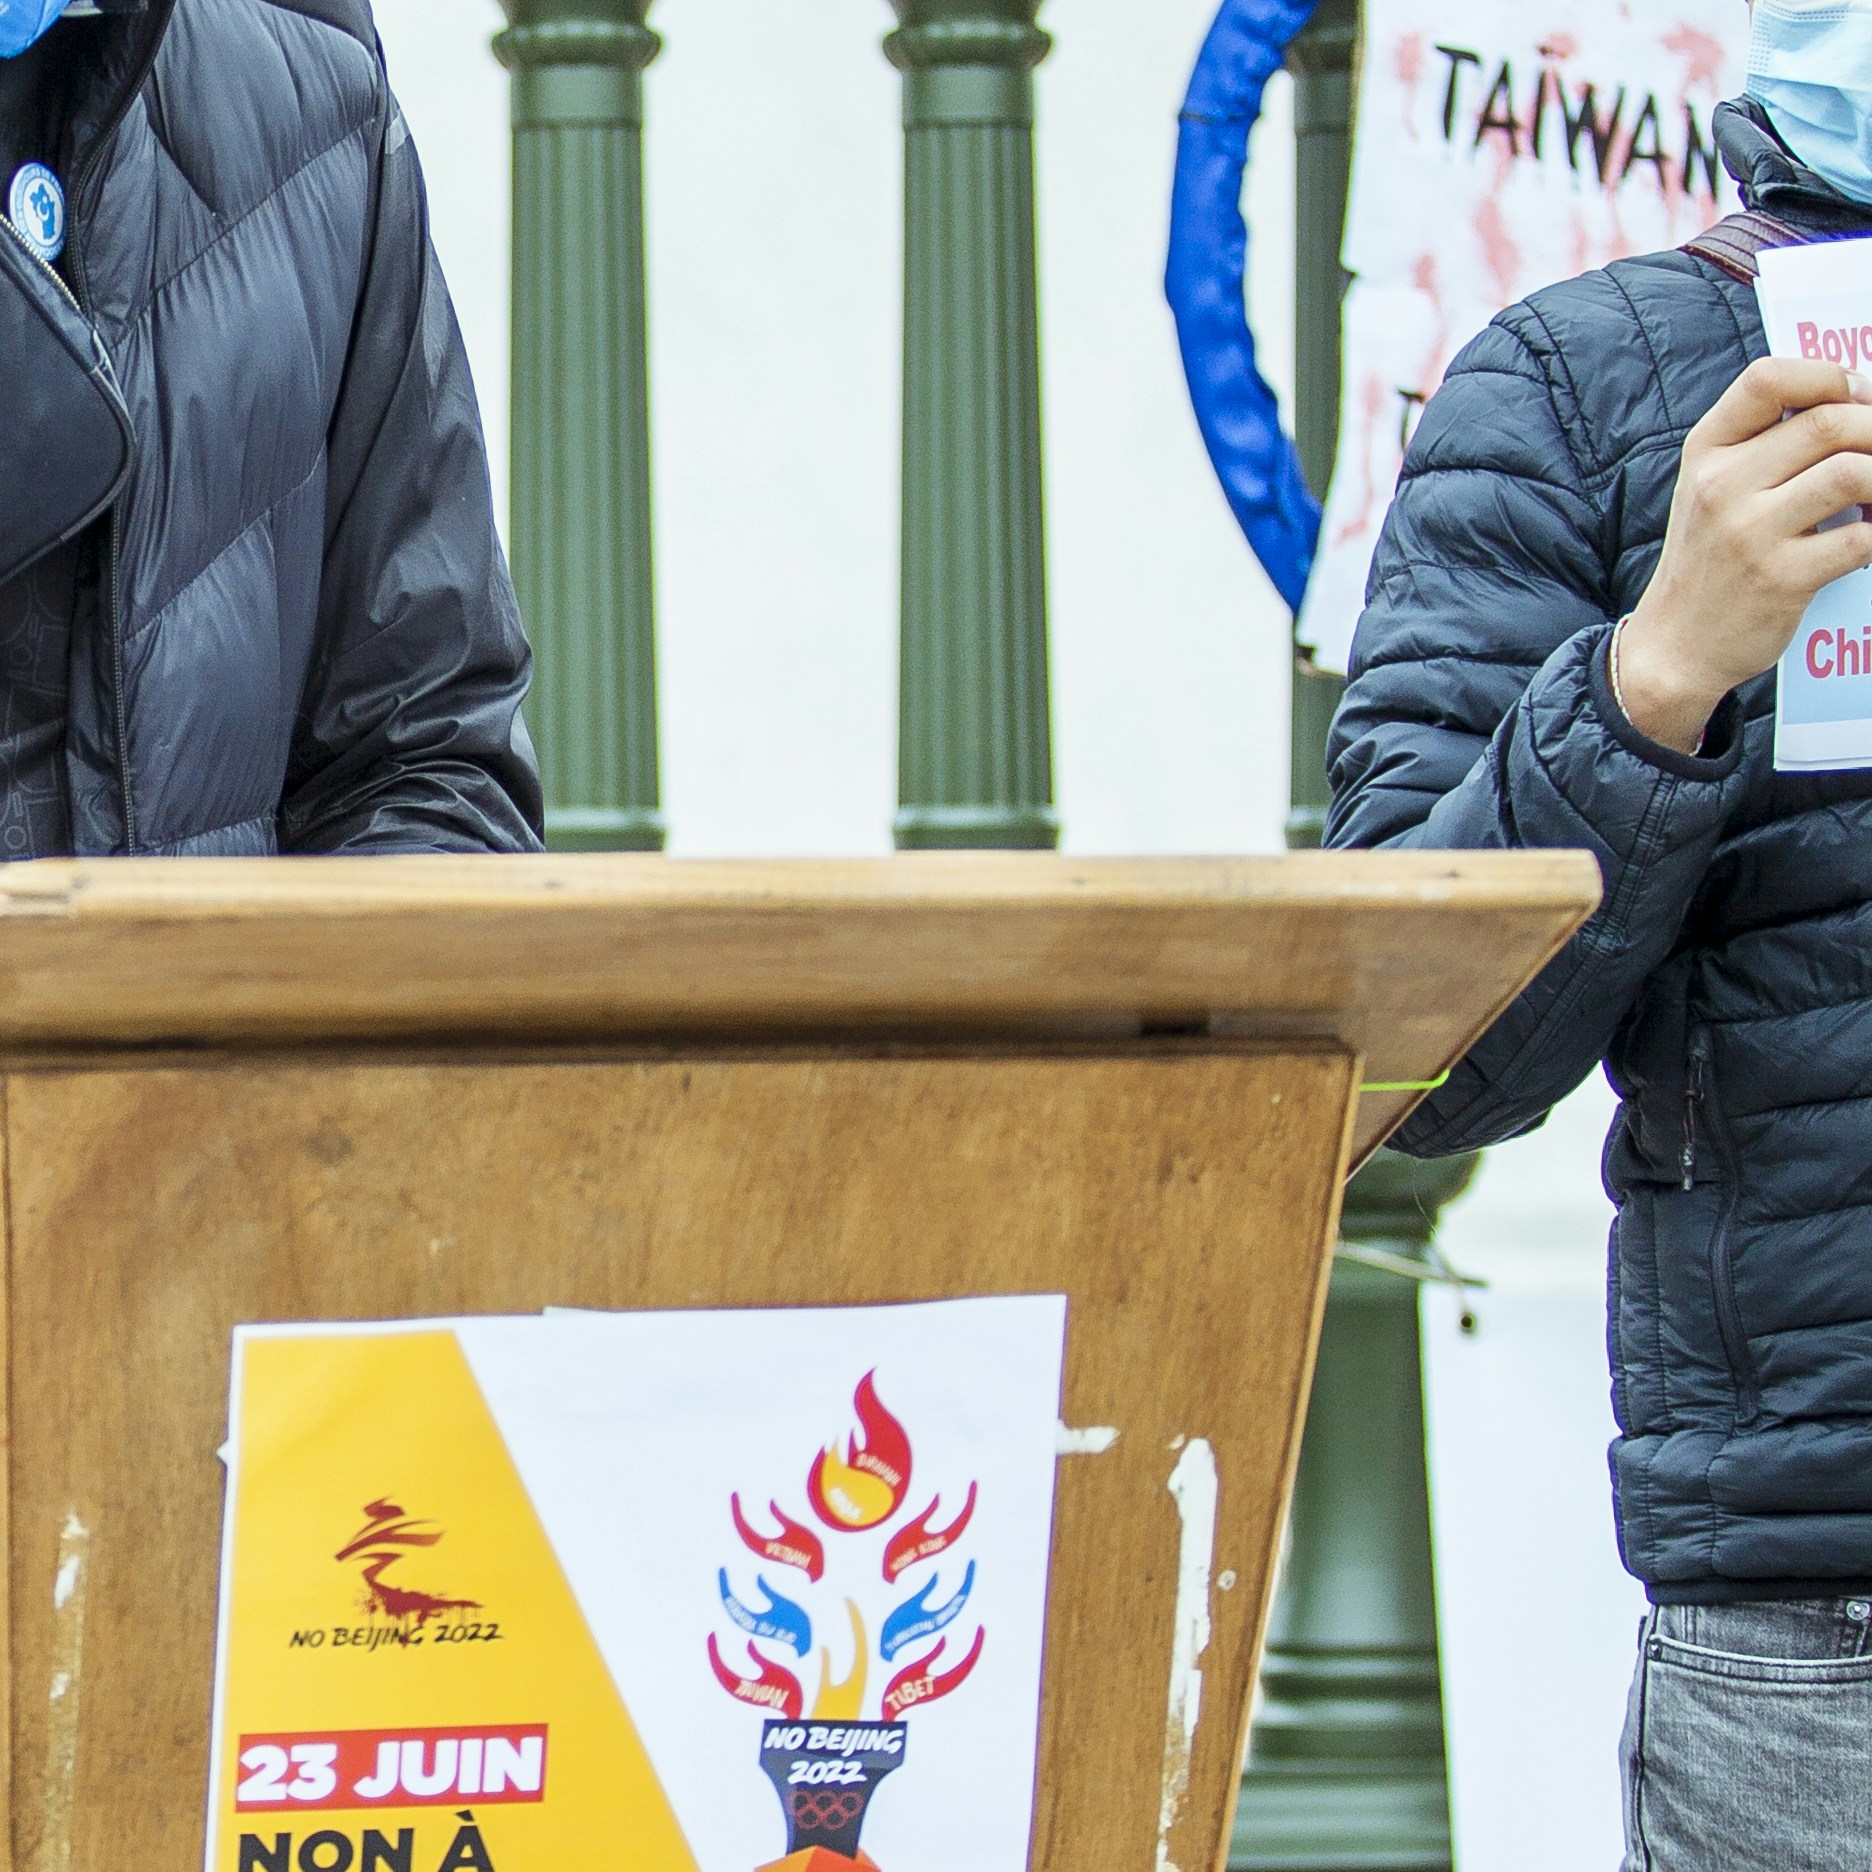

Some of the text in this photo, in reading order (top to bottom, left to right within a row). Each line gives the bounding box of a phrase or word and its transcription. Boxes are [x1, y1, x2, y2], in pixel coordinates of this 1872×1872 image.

[290, 1622, 504, 1653] NO BEIJING 2022
[884, 1675, 937, 1710] TIBET
[763, 1726, 904, 1757] NO BEIJING
[236, 1736, 543, 1803] 23 JUIN
[787, 1760, 868, 1785] 2022
